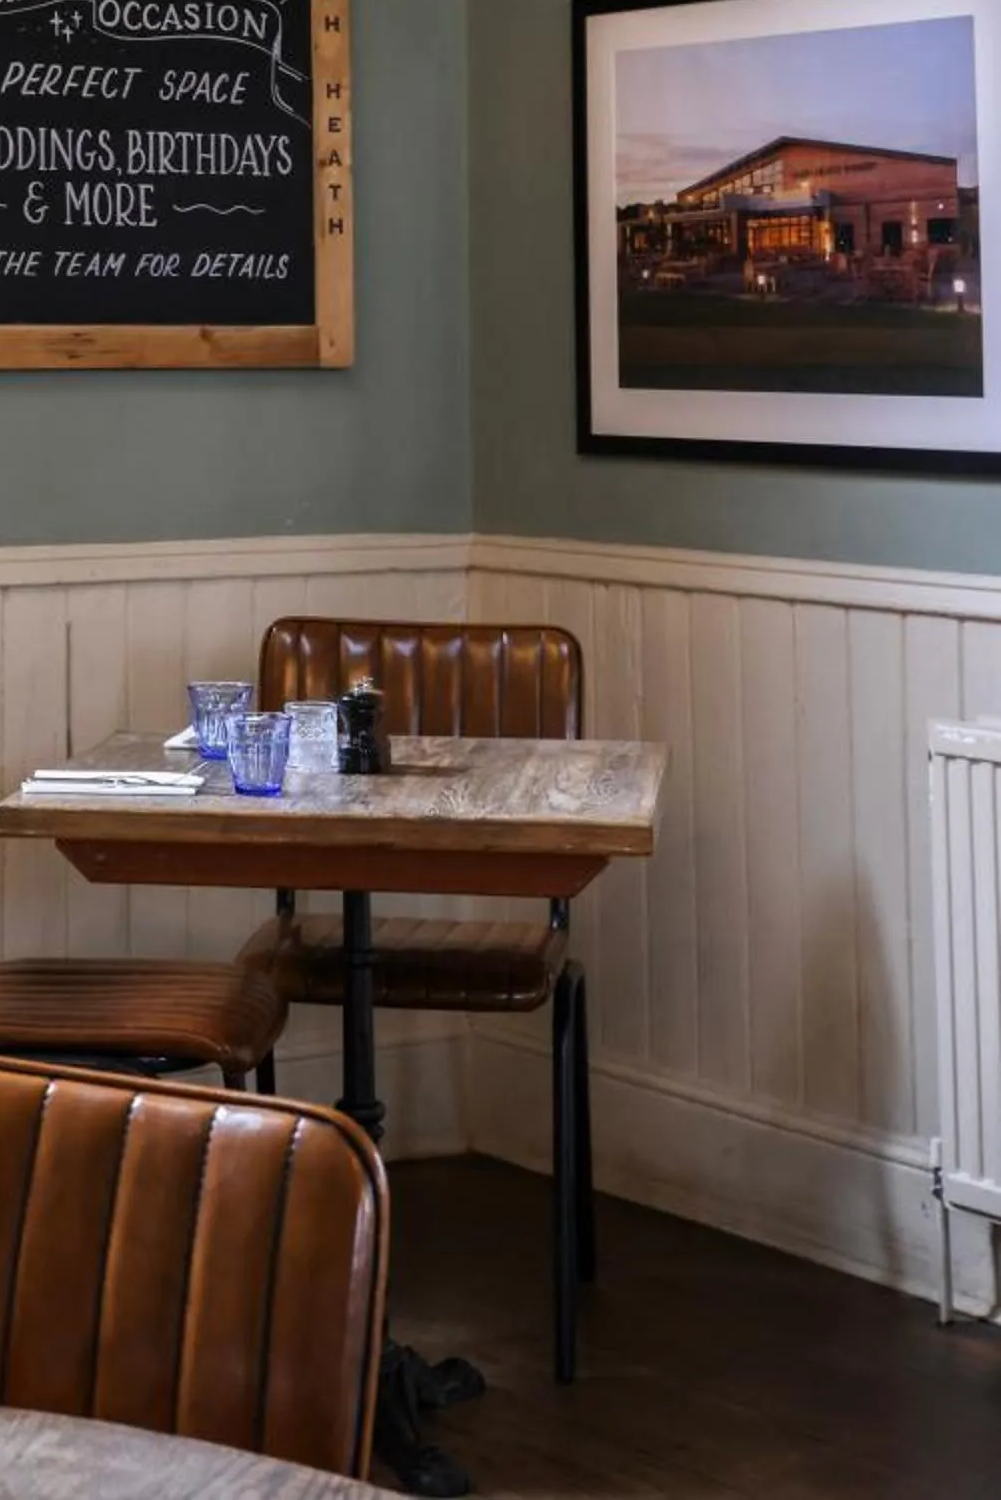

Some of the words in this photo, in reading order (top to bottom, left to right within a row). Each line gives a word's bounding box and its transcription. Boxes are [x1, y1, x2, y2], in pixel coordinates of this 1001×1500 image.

[0, 61, 142, 99] PERFECT
[158, 69, 250, 105] SPACE
[125, 130, 292, 177] BIRTHDAYS
[326, 82, 344, 236] HEATH
[23, 180, 50, 225] &
[63, 182, 158, 227] MORE
[53, 251, 126, 277] TEAM
[134, 253, 181, 278] FOR
[190, 252, 290, 280] DETAILS
